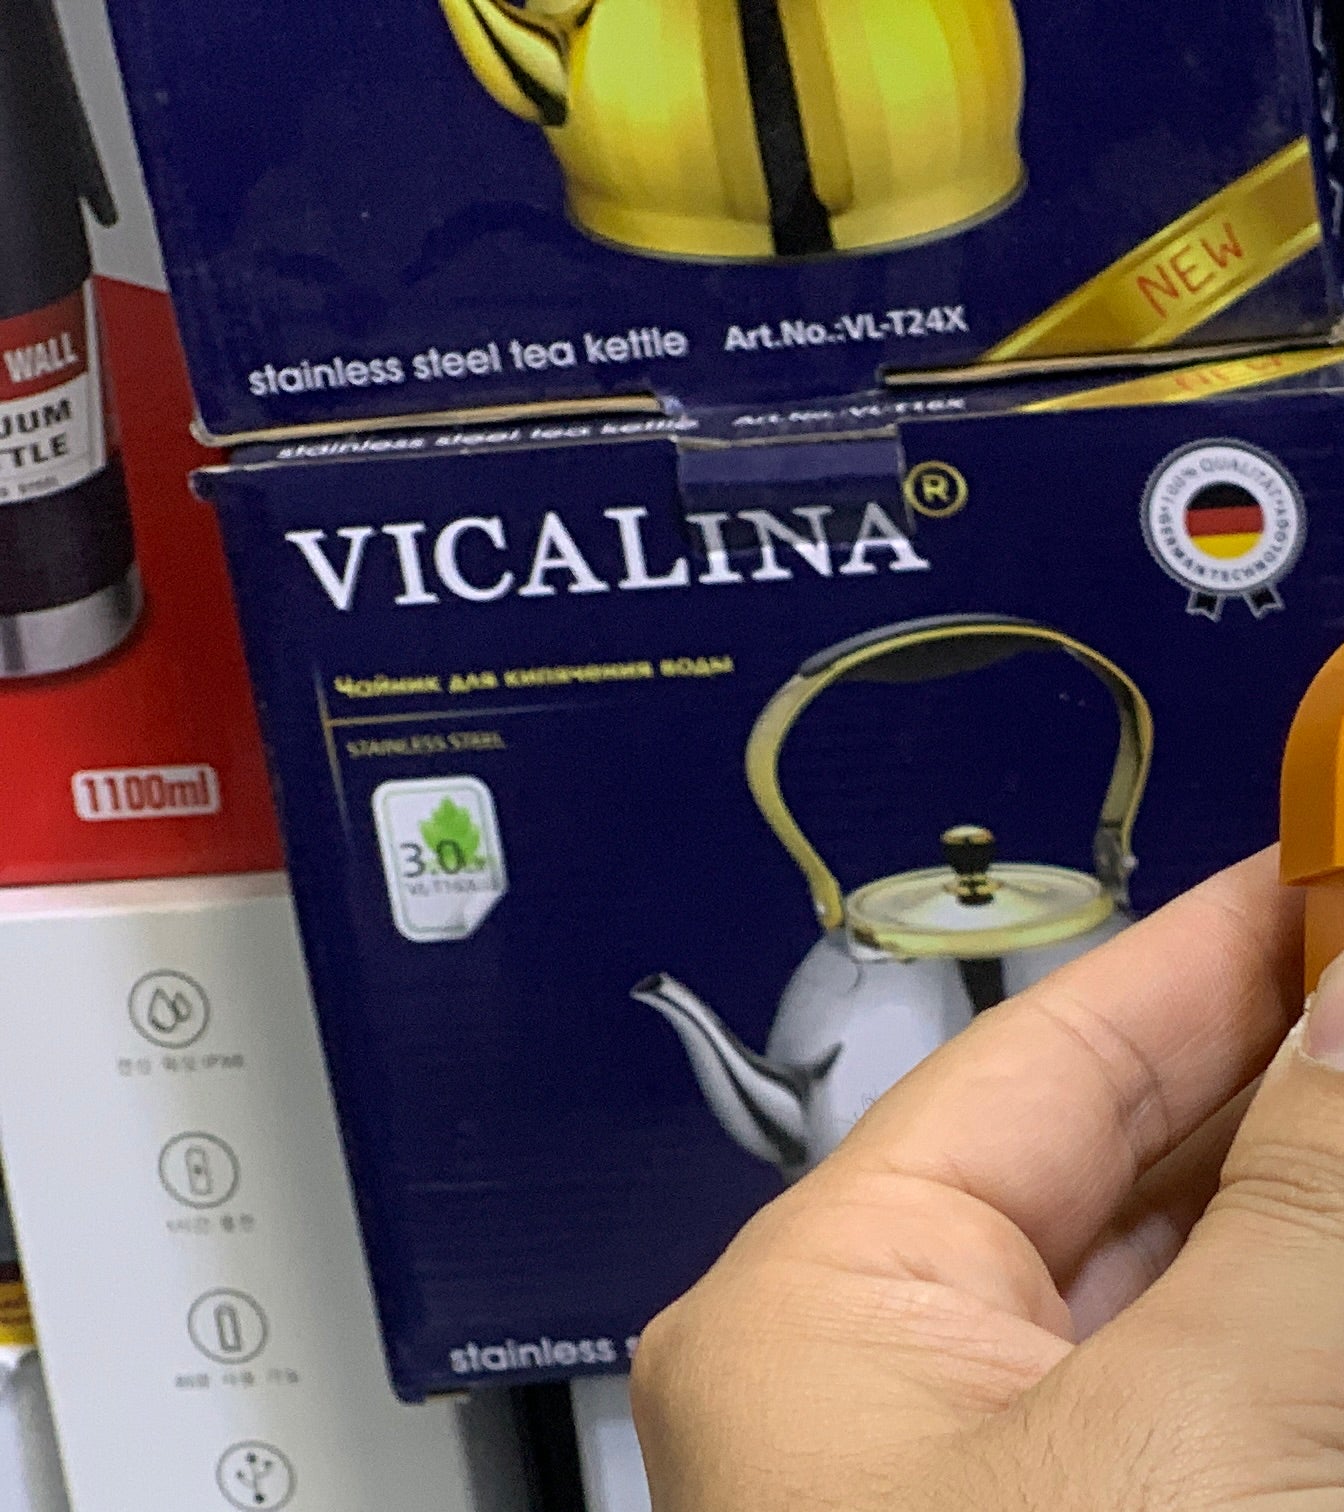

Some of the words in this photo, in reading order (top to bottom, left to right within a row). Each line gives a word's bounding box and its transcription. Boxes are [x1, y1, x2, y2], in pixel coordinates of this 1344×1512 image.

[1136, 222, 1246, 320] NEW
[4, 332, 79, 383] WALL
[249, 354, 405, 397] stainless
[412, 342, 503, 382] steel
[509, 341, 576, 370] tea
[584, 328, 690, 364] kettle
[286, 500, 930, 612] VICALINA
[81, 777, 212, 814] 1100ml
[450, 1334, 616, 1375] stainless
